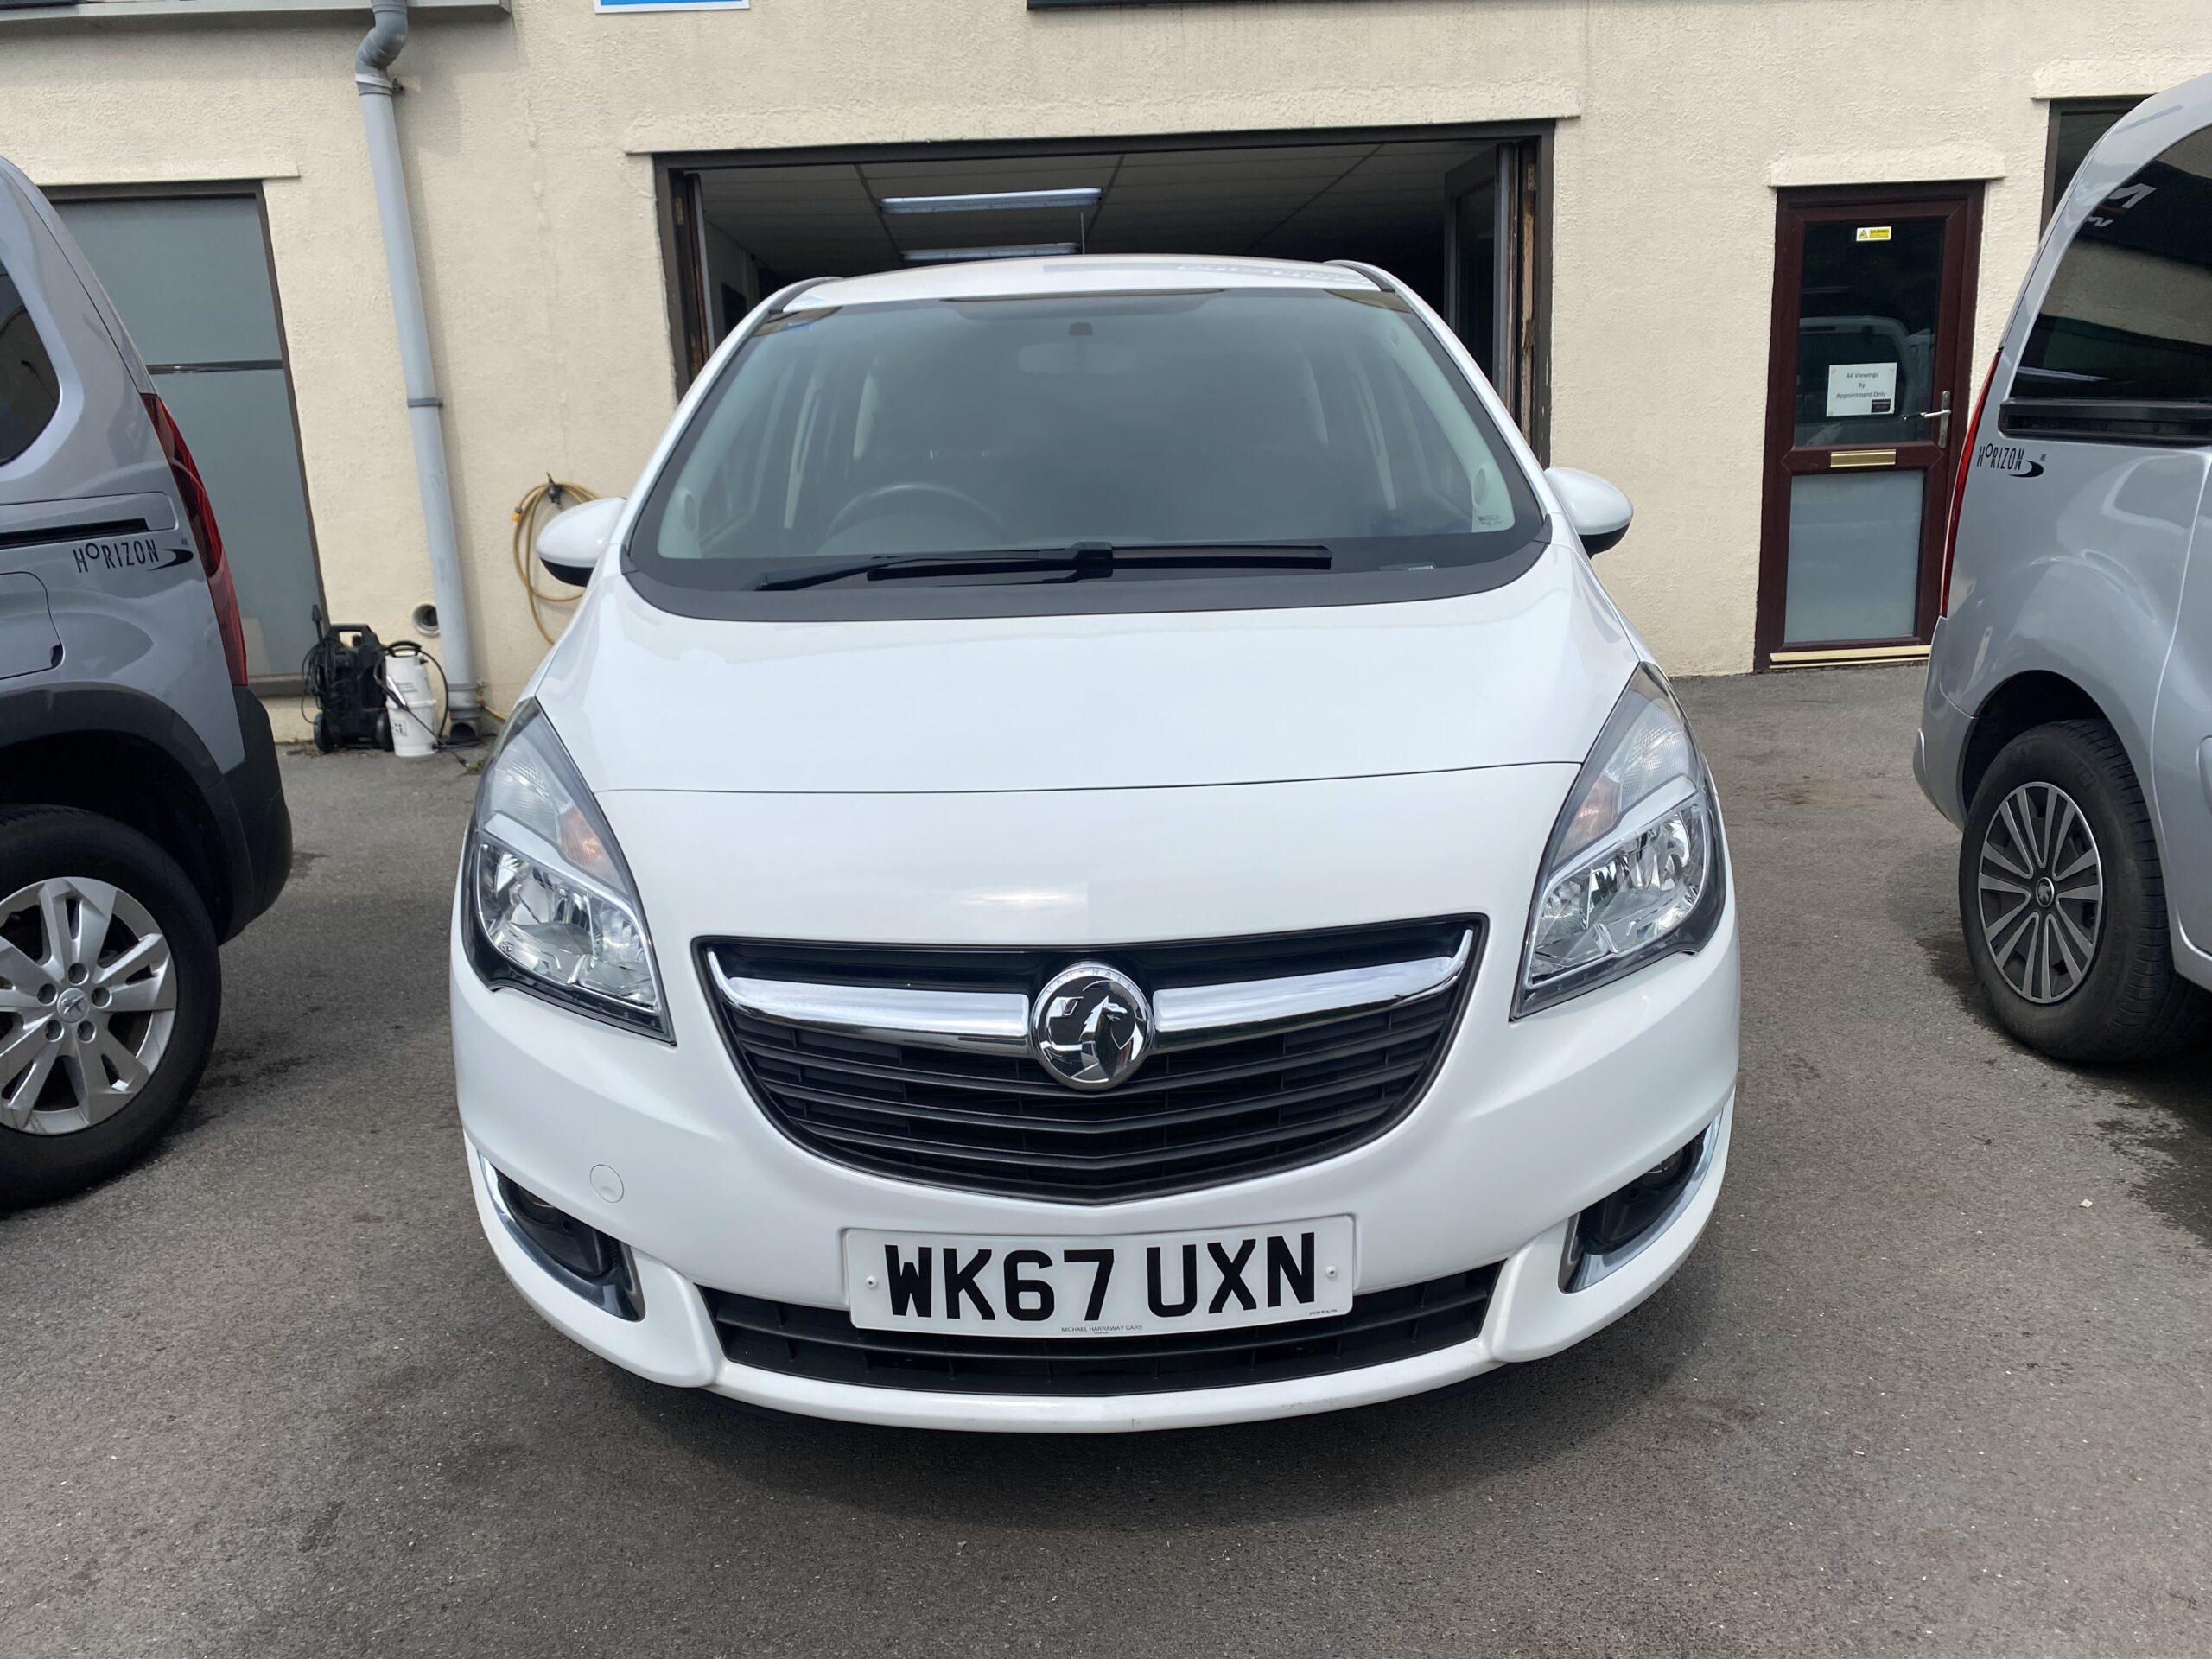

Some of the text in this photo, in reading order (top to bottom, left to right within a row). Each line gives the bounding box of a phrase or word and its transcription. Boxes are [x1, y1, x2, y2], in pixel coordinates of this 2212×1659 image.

[1977, 442, 2024, 470] HORIZON
[73, 538, 159, 573] HORIZON
[885, 1231, 1315, 1321] WK67 UXN
